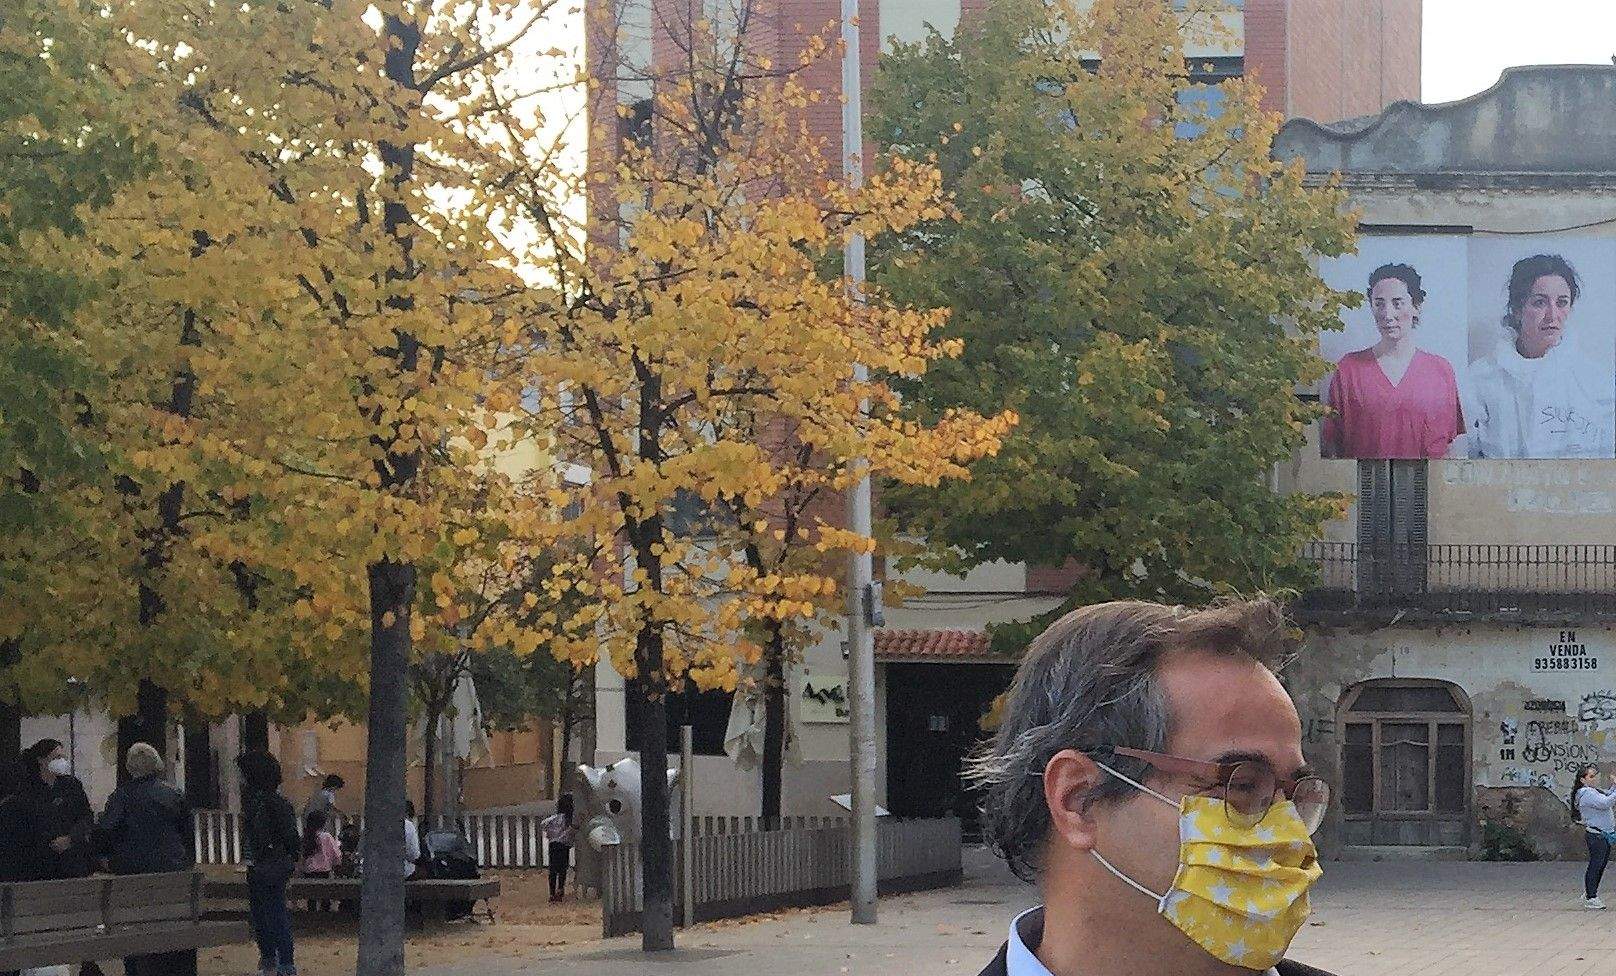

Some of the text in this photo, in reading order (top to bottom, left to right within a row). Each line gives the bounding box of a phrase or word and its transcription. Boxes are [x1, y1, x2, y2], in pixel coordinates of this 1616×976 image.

[1559, 631, 1576, 643] EN
[1549, 644, 1587, 656] VENDA
[1534, 657, 1598, 670] 935883158
